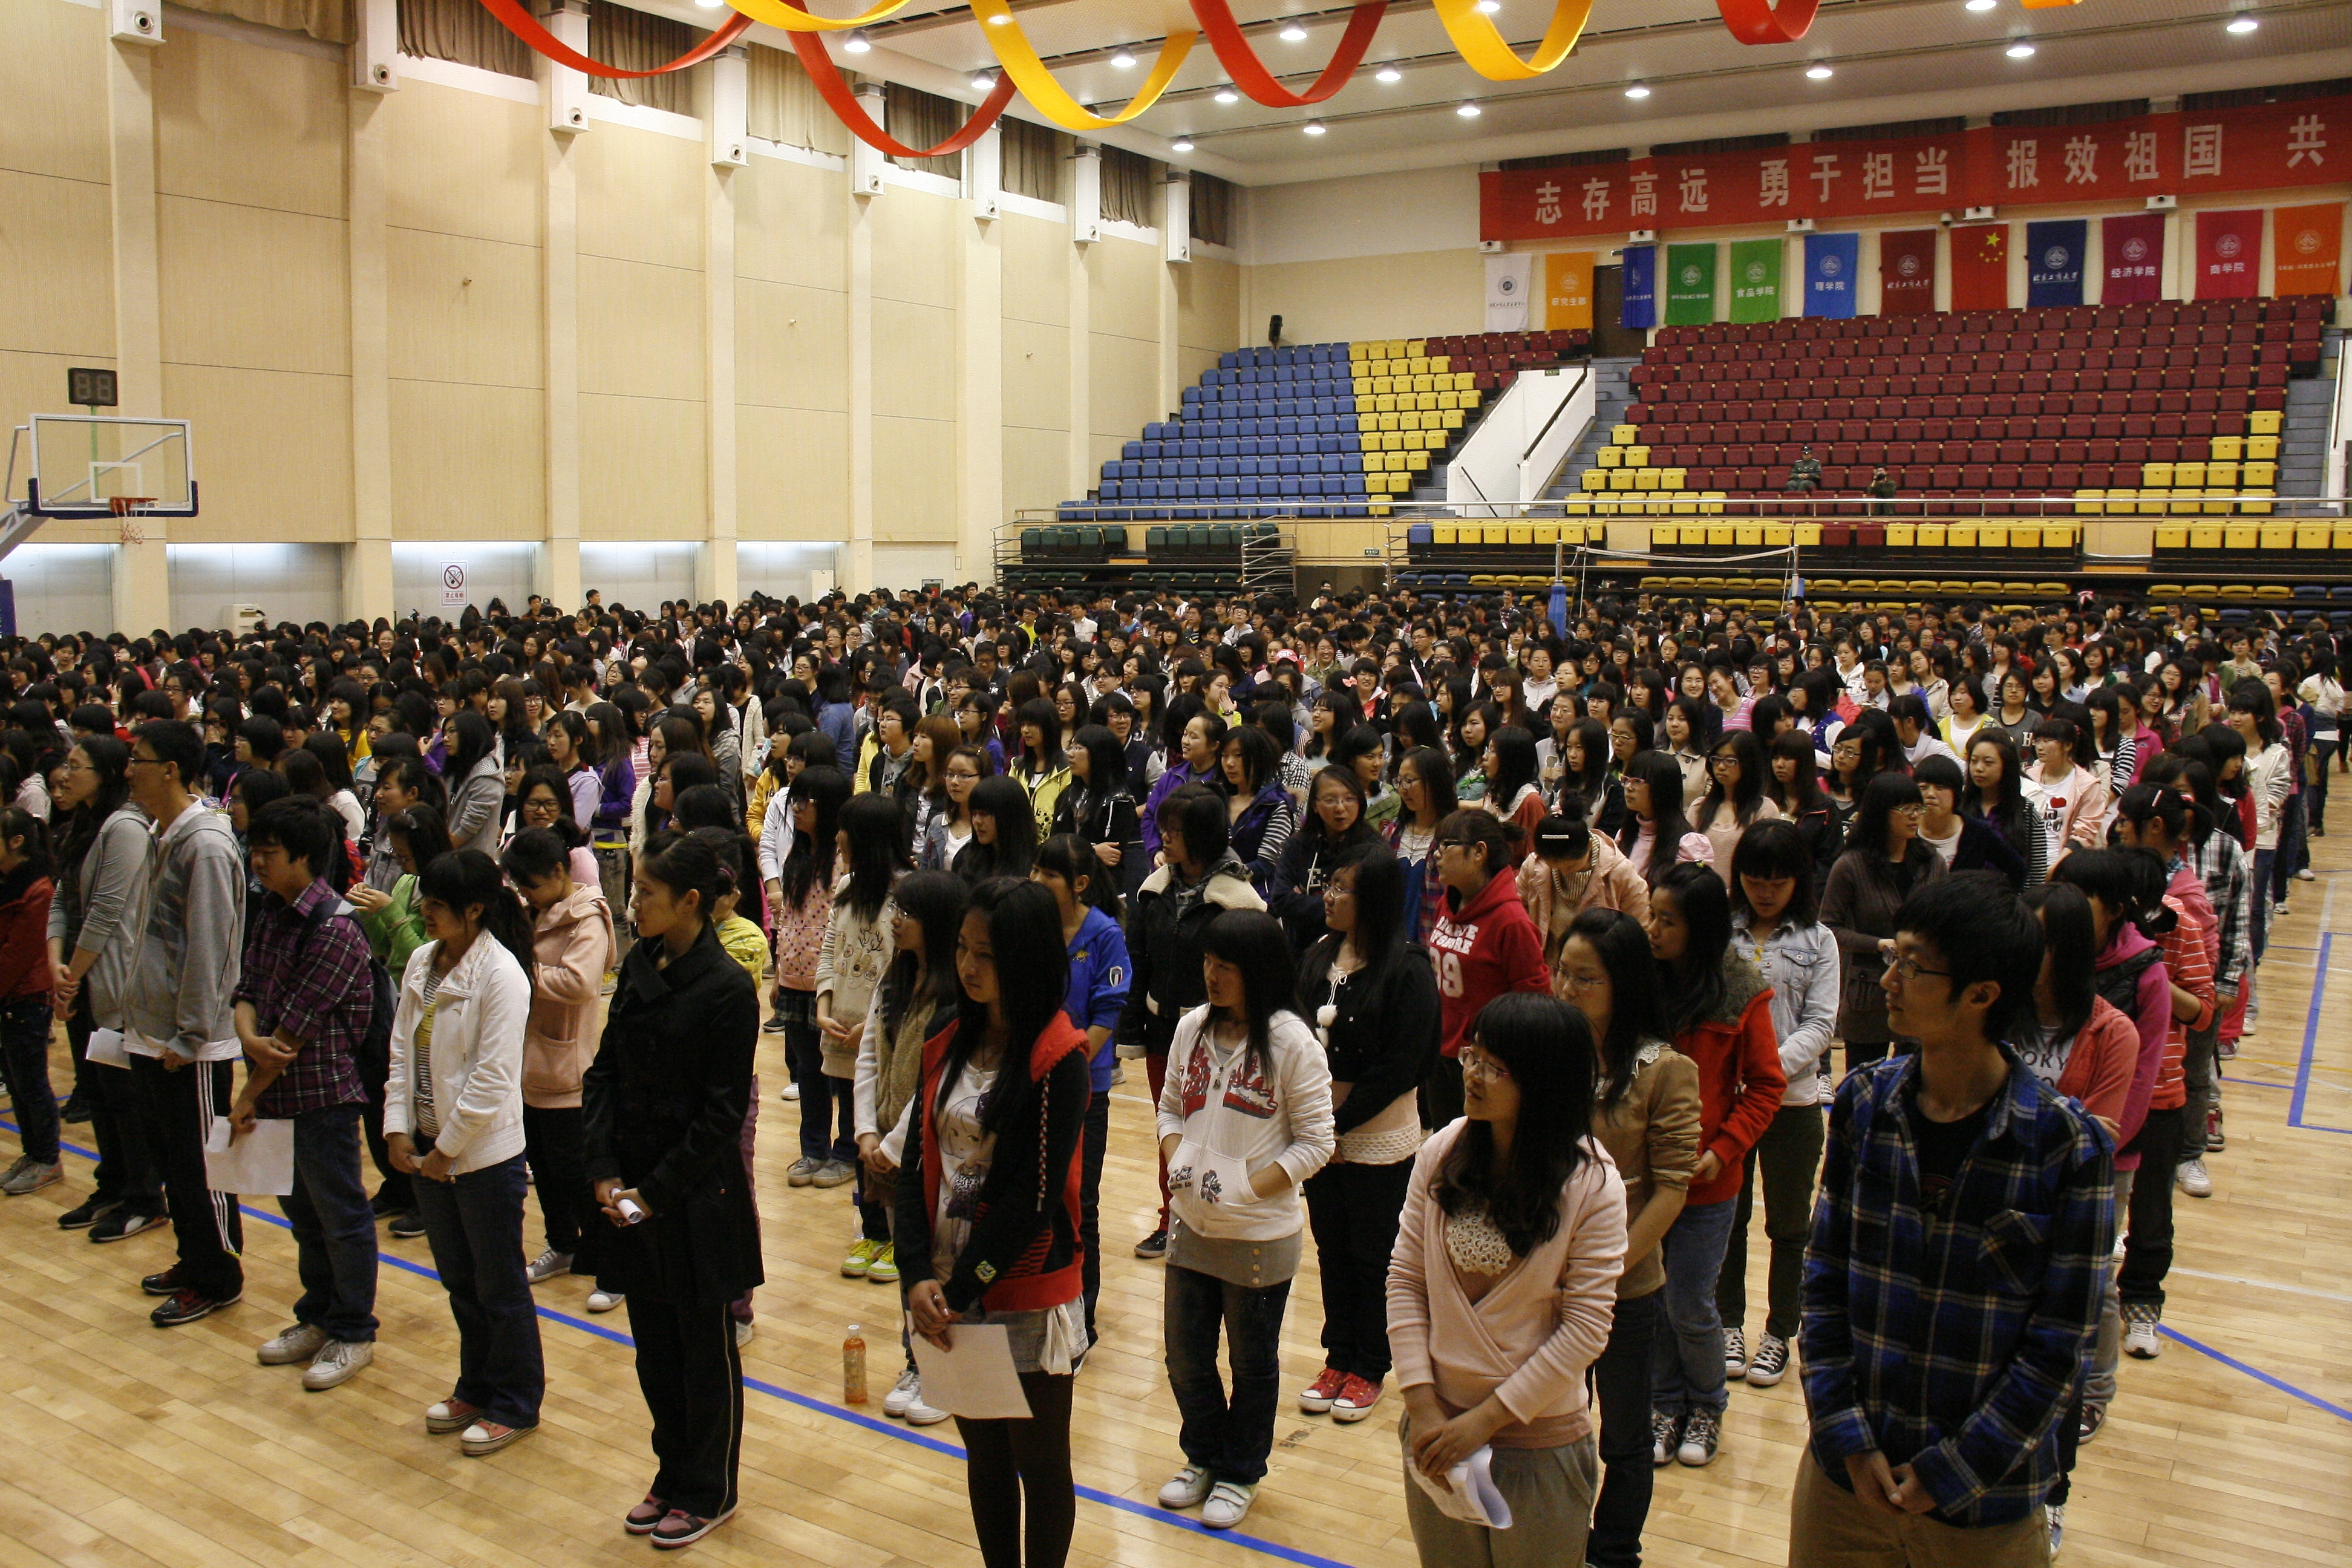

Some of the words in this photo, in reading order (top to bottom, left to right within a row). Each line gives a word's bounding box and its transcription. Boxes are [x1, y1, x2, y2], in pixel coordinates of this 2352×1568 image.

[1534, 168, 1710, 224] 志存高远
[1759, 146, 1947, 207] 勇于担当
[2007, 124, 2223, 189] 报效祖国
[2287, 114, 2327, 168] 共
[2111, 266, 2156, 278] 经济学院
[2210, 262, 2245, 275] 商学院
[1736, 286, 1775, 298] 食品学院
[1815, 281, 1844, 291] 理学院
